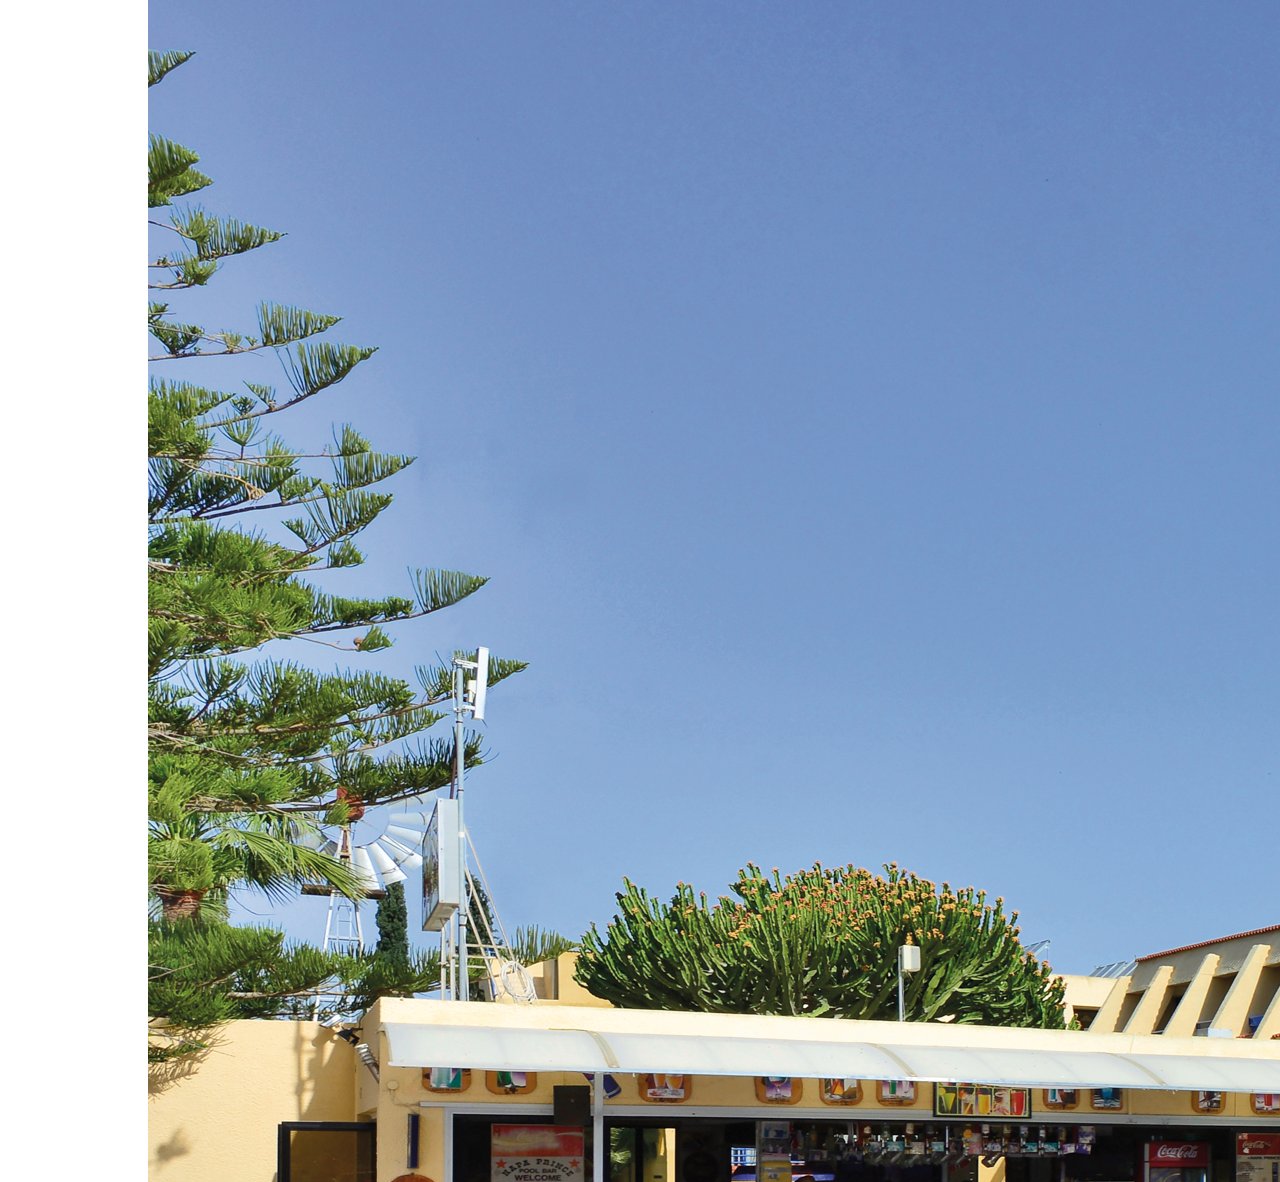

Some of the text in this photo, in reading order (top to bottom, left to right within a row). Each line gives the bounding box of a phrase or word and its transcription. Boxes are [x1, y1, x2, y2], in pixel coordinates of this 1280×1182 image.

[1157, 1144, 1200, 1158] Coca-Cola
[502, 1158, 575, 1177] NAPA PRINCE
[514, 1174, 562, 1182] WELCOME
